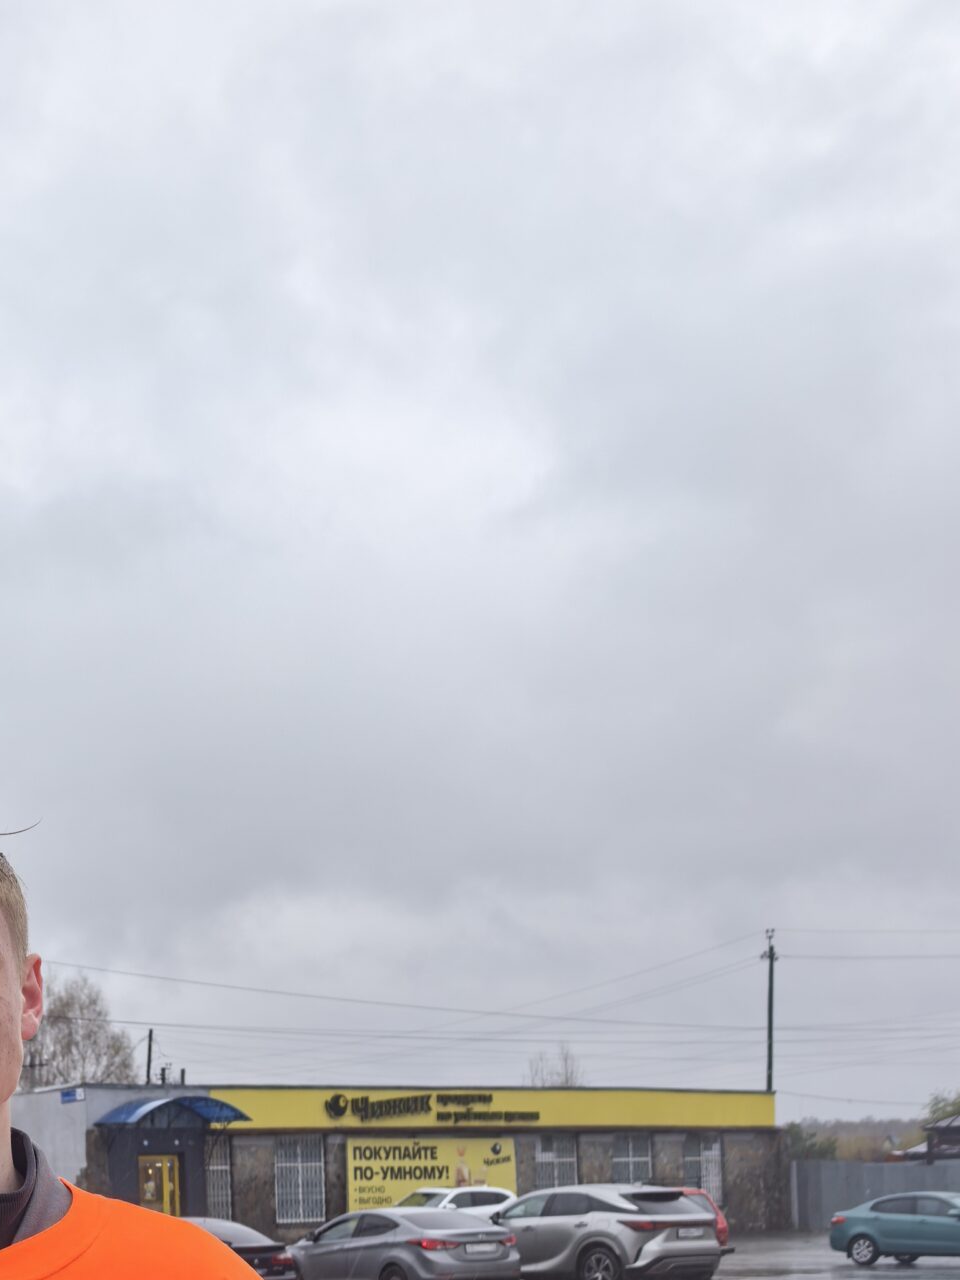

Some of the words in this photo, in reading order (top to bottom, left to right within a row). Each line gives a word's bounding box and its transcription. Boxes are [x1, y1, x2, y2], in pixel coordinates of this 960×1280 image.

[351, 1094, 432, 1122] Чижик
[353, 1141, 438, 1161] ПОКУПАЙТЕ
[483, 1154, 512, 1167] Чижик
[353, 1165, 450, 1181] ПО-УМНОМУ!
[358, 1185, 385, 1194] ВКУСНО
[358, 1196, 393, 1205] ВЫГОДНО
